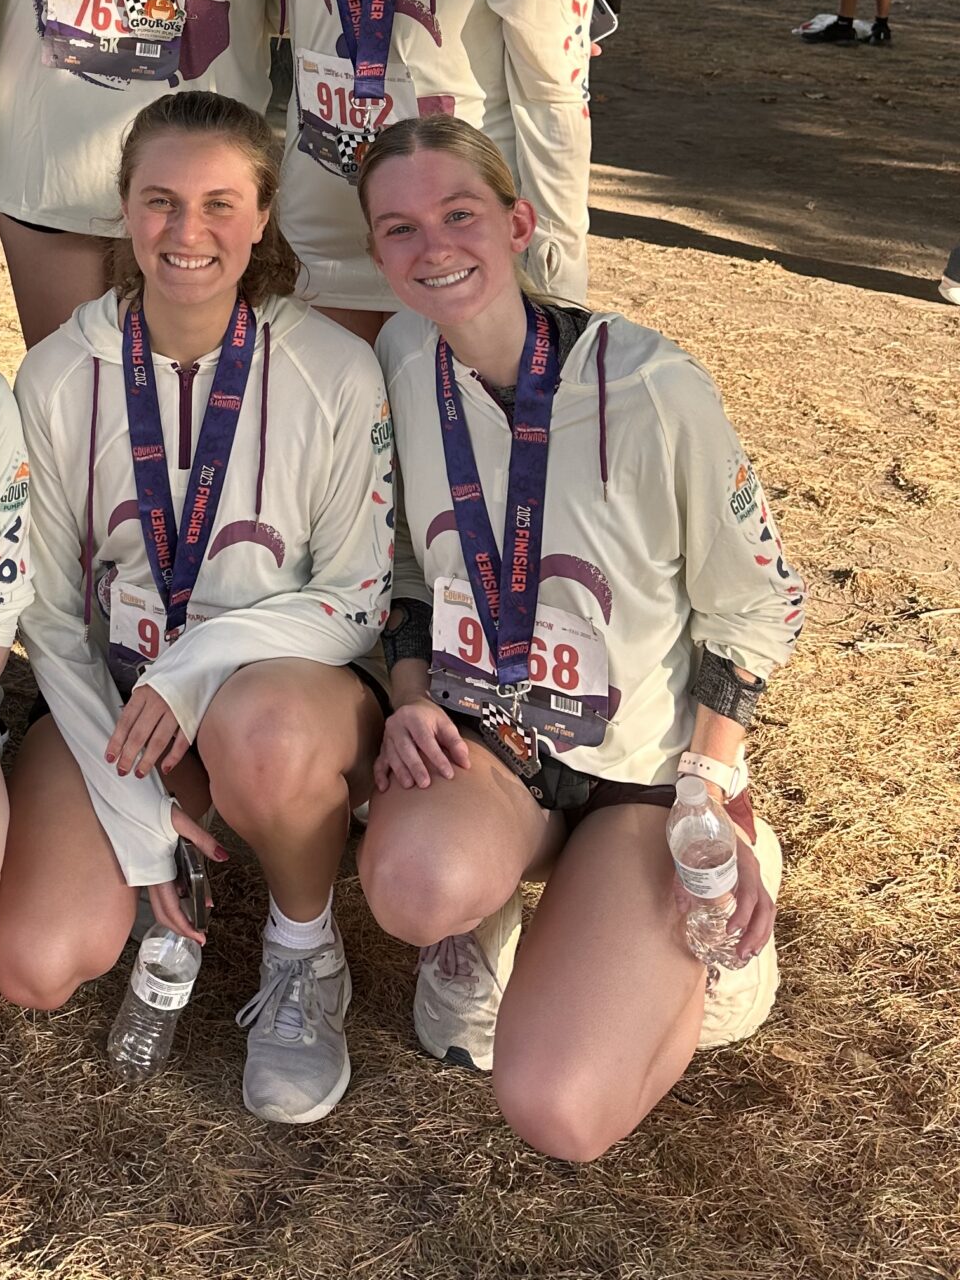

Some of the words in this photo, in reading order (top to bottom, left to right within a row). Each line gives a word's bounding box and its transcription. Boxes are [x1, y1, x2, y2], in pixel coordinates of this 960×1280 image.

[99, 37, 119, 54] 5K
[530, 312, 550, 376] FINISHER
[135, 366, 147, 387] 2025
[446, 399, 458, 421] 2025
[514, 431, 548, 443] GOURDY'S
[133, 445, 164, 457] GOURDY'S
[200, 464, 215, 485] 2025
[452, 483, 480, 496] GOURDY'S
[185, 486, 210, 545] FINISHER
[516, 505, 530, 527] 2025
[151, 507, 172, 568] FINISHER
[511, 529, 529, 593] FINISHER
[476, 552, 500, 618] FINISHER
[443, 590, 473, 605] GOURDY'S
[458, 617, 580, 691] 968
